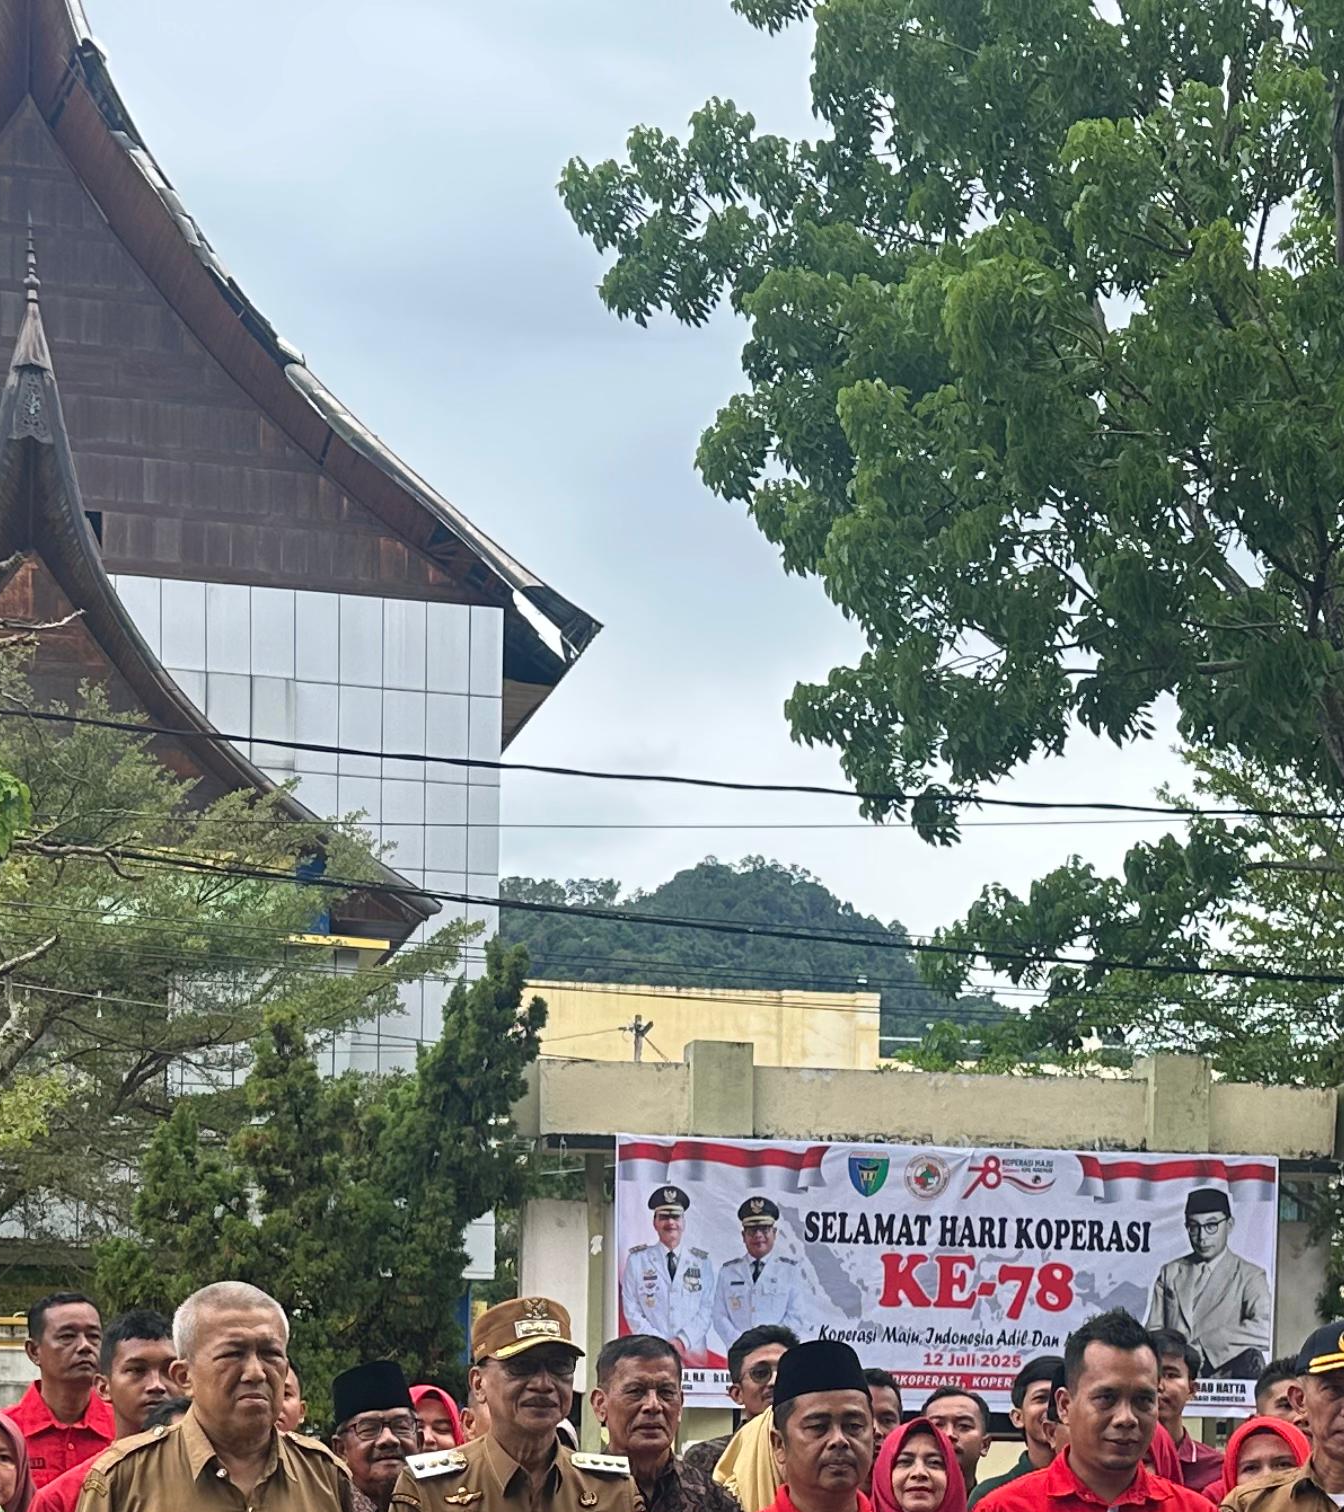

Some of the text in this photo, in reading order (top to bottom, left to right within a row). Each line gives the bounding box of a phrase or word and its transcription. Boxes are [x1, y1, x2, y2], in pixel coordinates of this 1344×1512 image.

[805, 1211, 1151, 1252] SELAMAT HARI KOPERASI
[878, 1253, 1074, 1321] KE-78
[819, 1325, 877, 1345] Koperasi
[925, 1327, 993, 1346] Indonesia
[996, 1329, 1027, 1346] Adil
[1031, 1331, 1059, 1347] Dan
[923, 1353, 1021, 1368] 12 Juli 2025
[972, 1377, 1015, 1389] KOPER
[1216, 1382, 1246, 1394] HATTA
